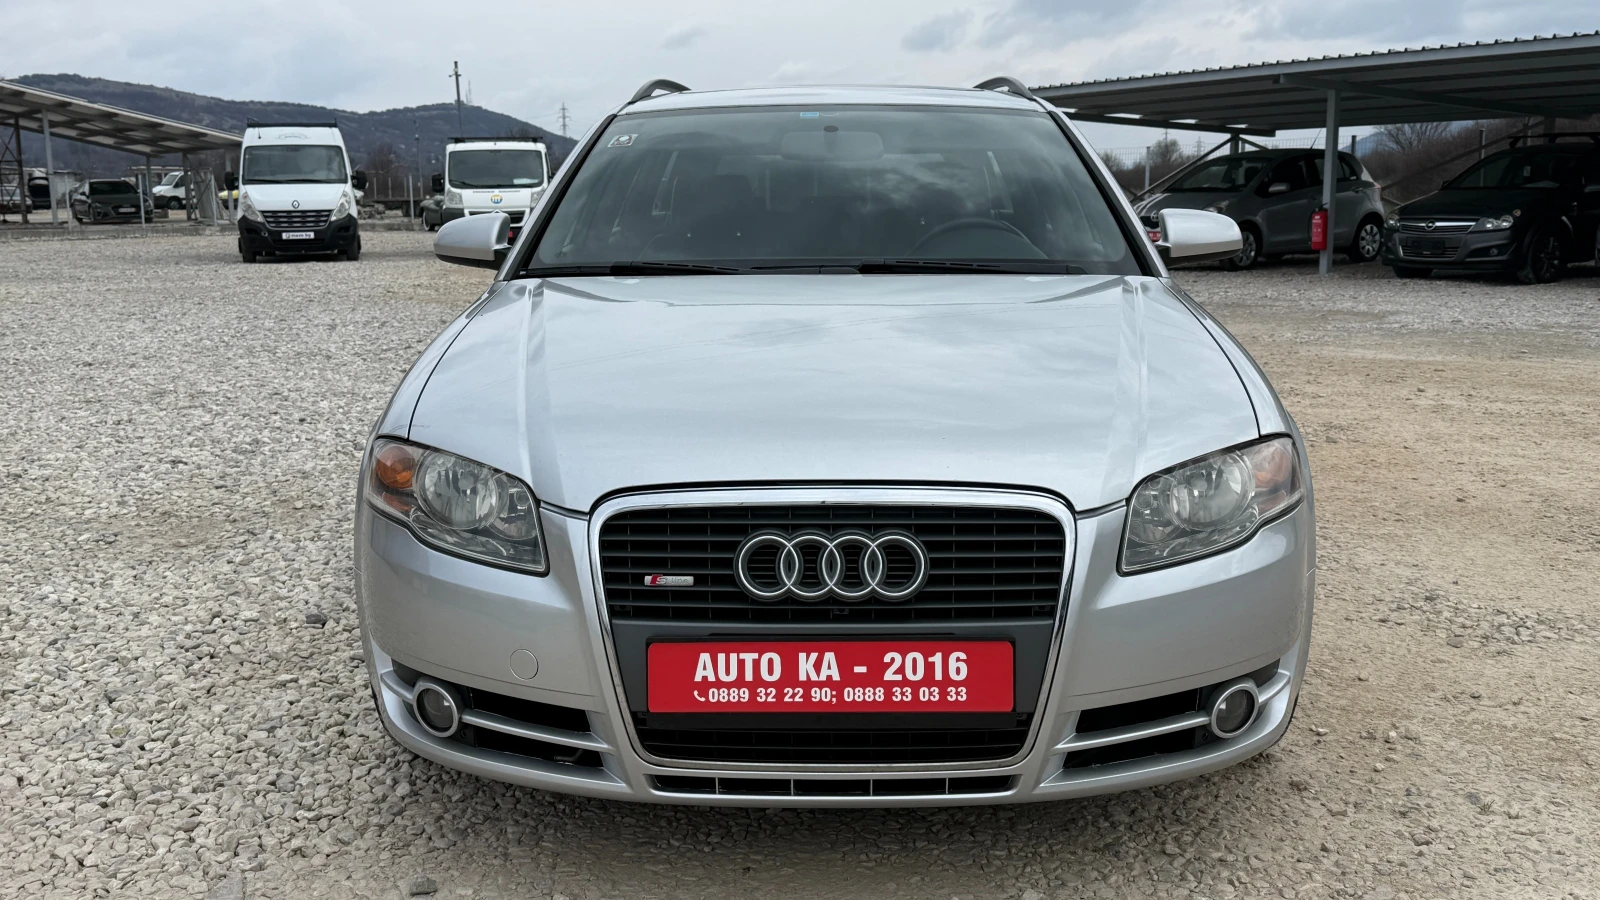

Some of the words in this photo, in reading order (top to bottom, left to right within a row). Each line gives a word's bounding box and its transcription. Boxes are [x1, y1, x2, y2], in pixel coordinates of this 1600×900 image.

[694, 652, 782, 682] AUTO
[798, 651, 841, 682] KA
[853, 665, 868, 673] -
[884, 651, 968, 681] 2016
[708, 687, 750, 703] 0889
[756, 687, 777, 703] 32
[783, 687, 804, 702] 22
[810, 687, 837, 704] 90;
[843, 687, 885, 702] 0888
[891, 686, 912, 702] 33
[919, 686, 940, 702] 03
[946, 686, 967, 702] 33
